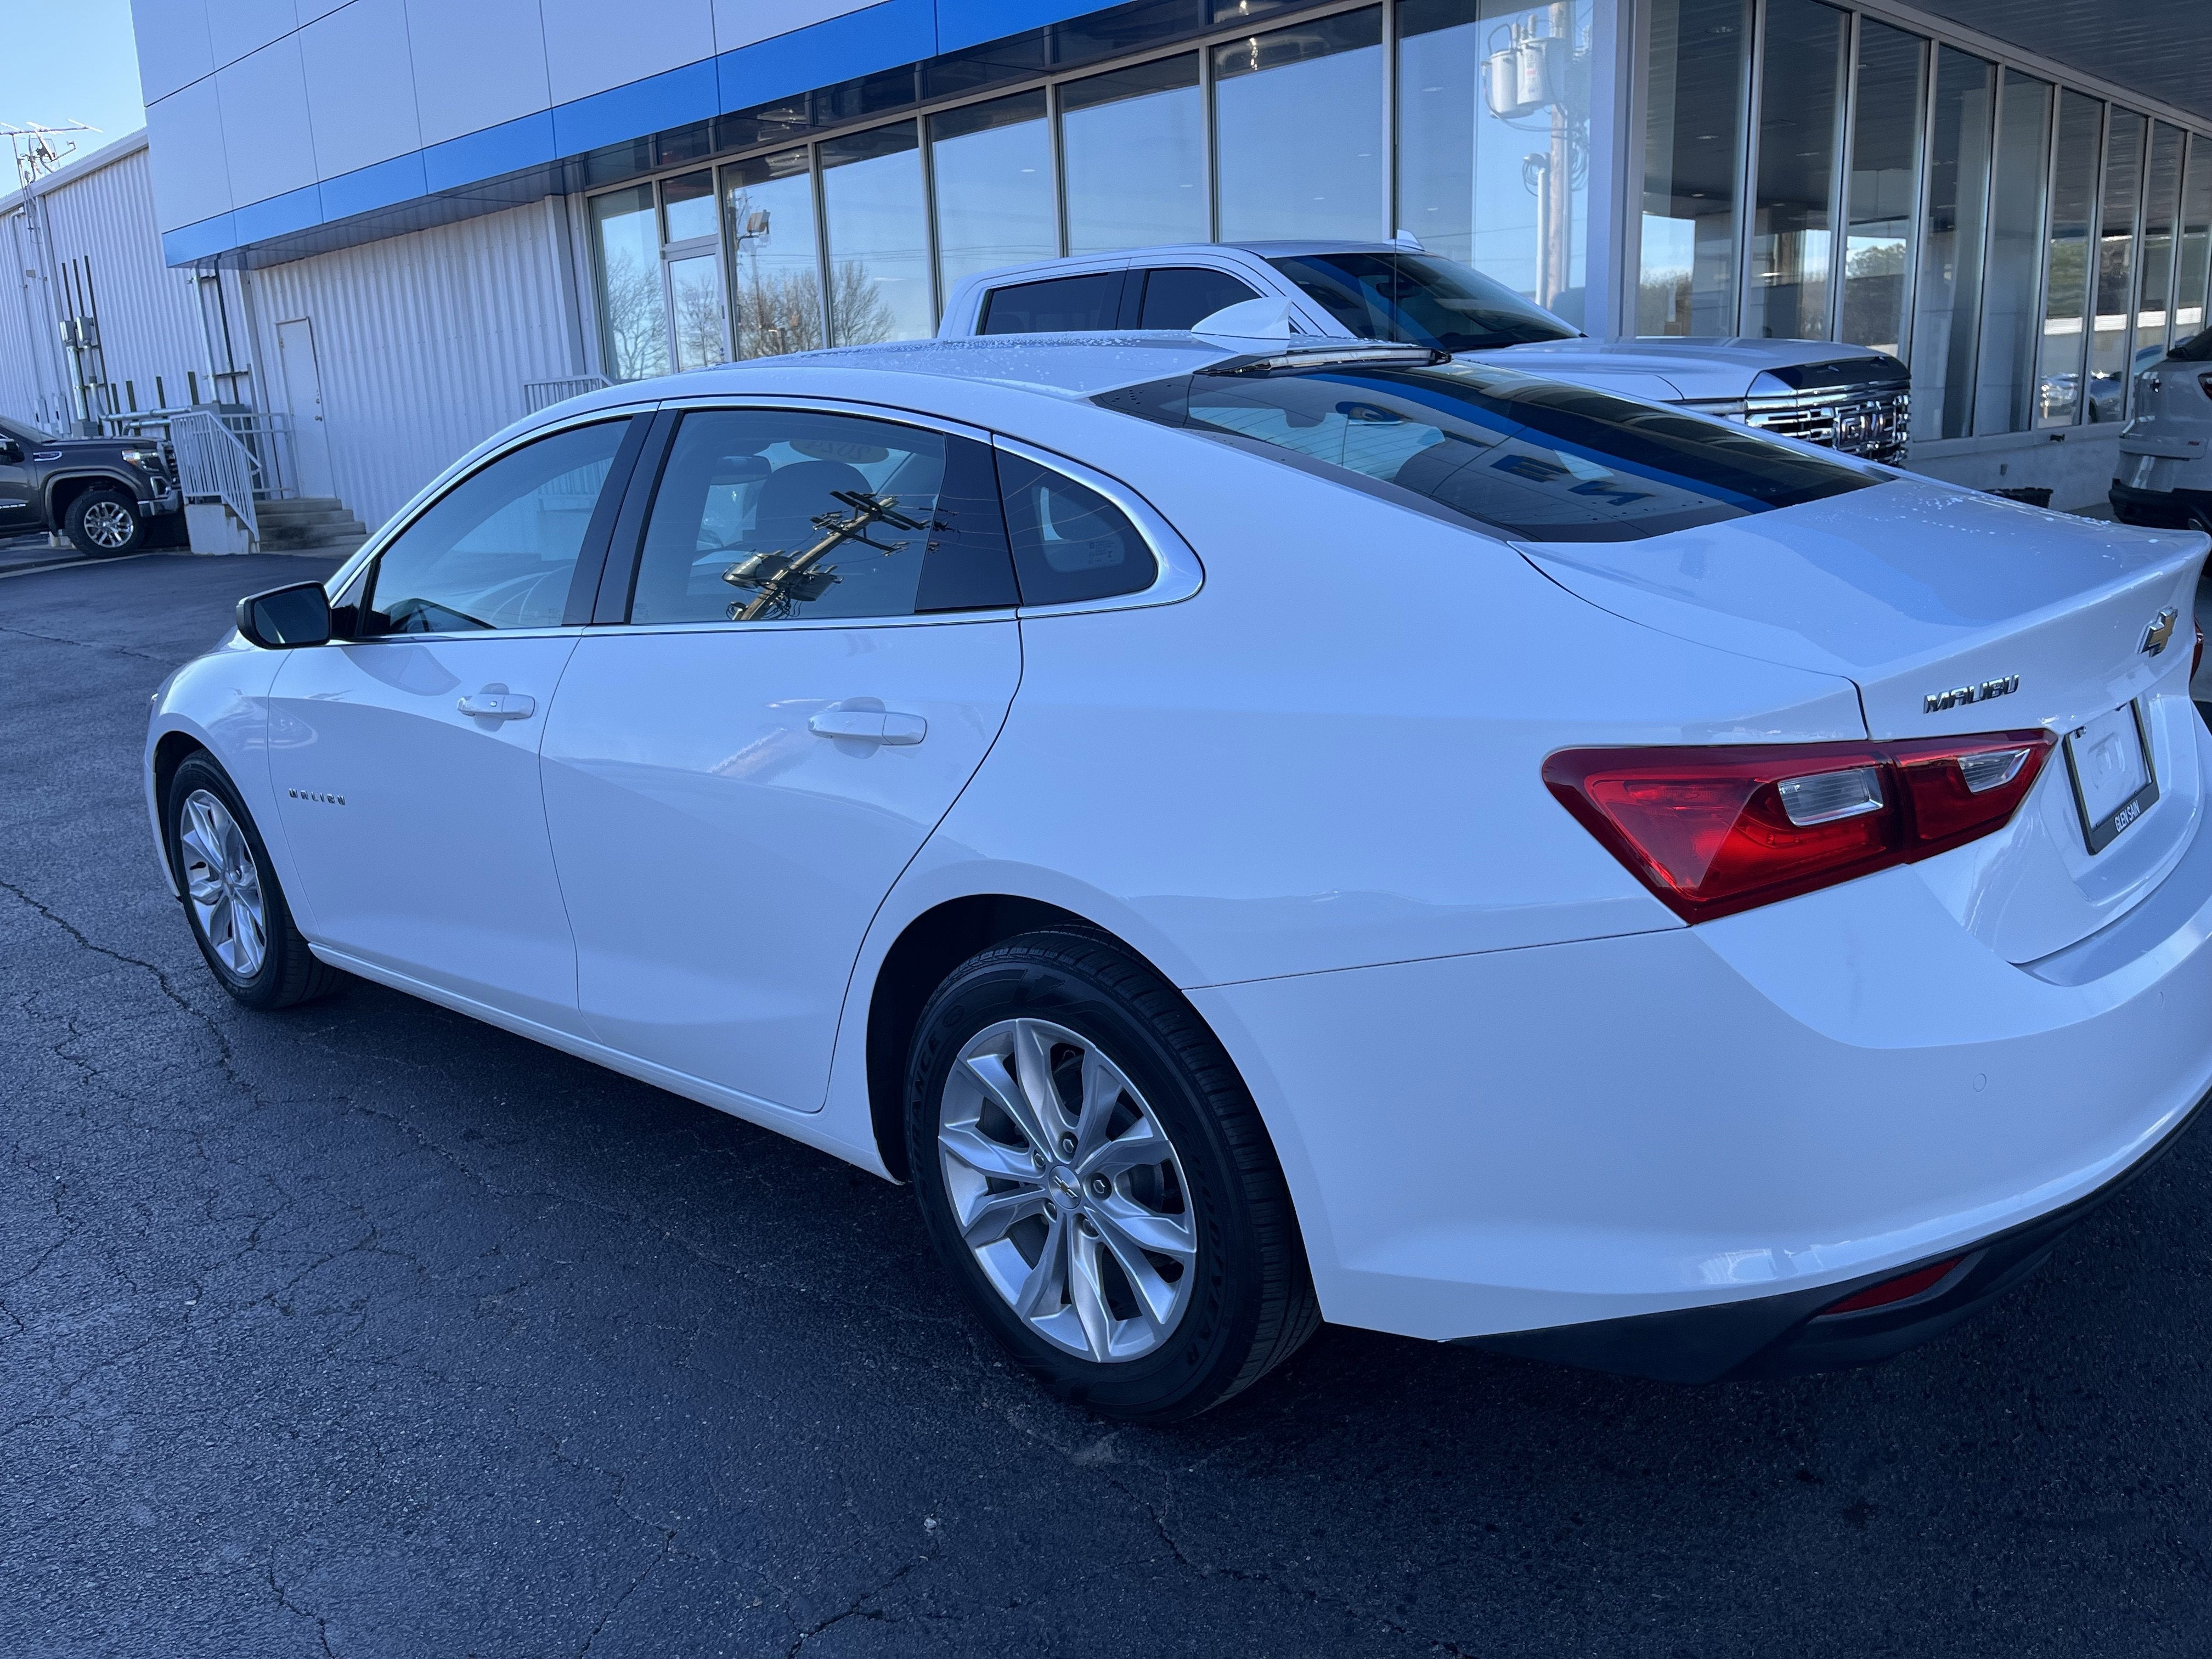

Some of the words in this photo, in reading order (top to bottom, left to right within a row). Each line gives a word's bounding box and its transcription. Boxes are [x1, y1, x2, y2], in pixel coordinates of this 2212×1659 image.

[1840, 413, 1893, 441] GMC
[1922, 673, 2019, 714] MALIBU
[289, 788, 346, 805] MALIBU
